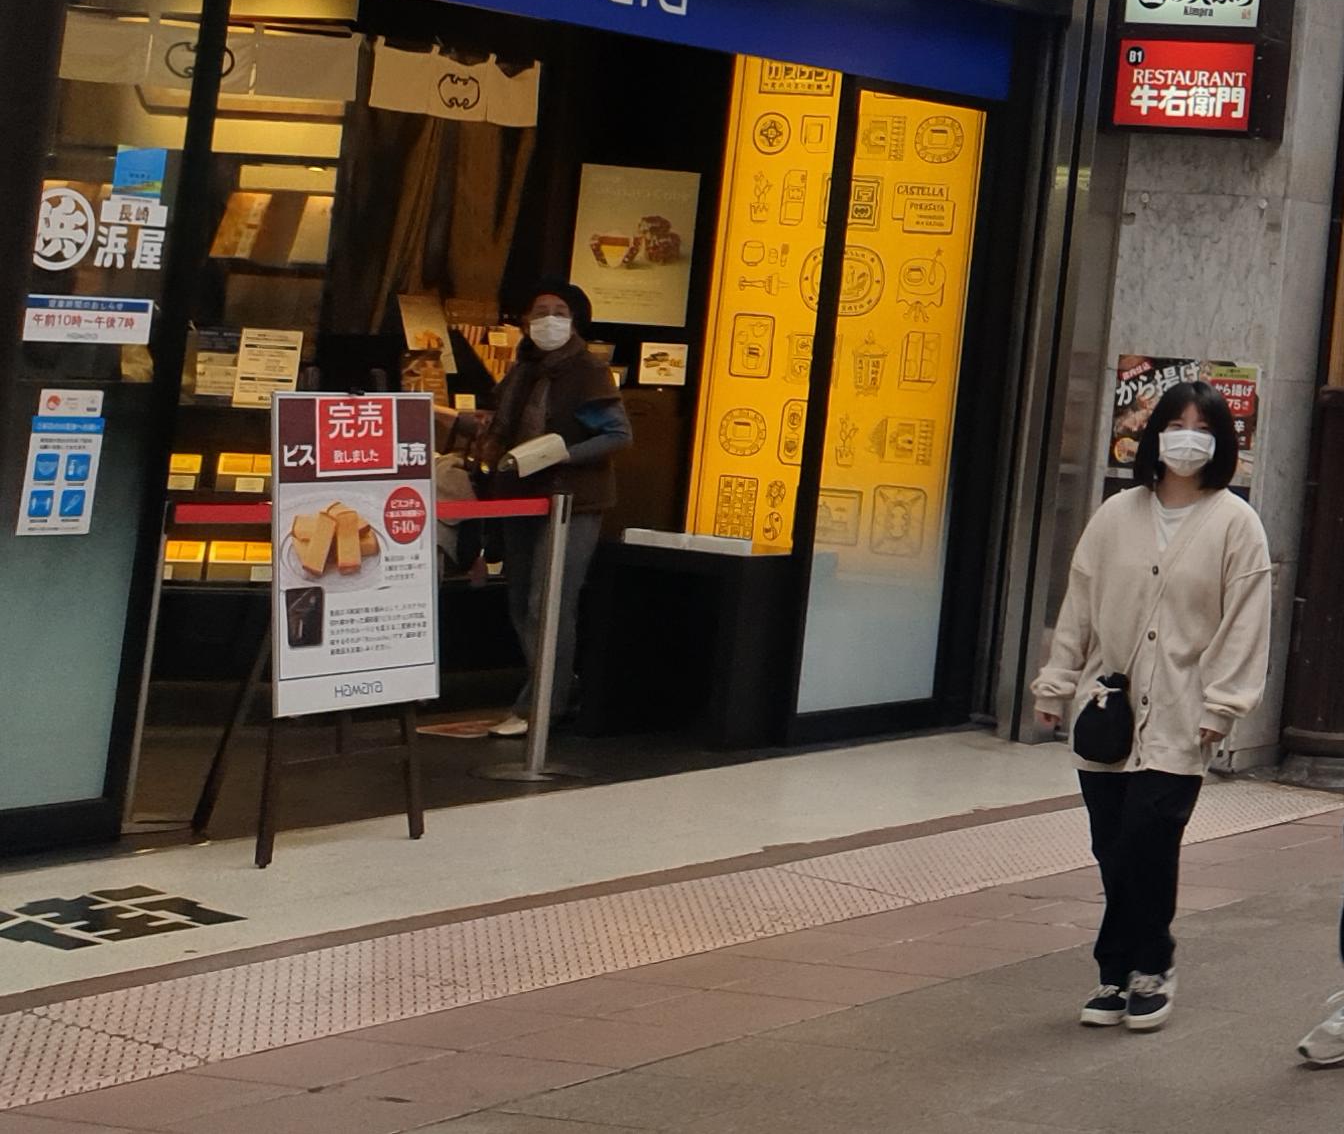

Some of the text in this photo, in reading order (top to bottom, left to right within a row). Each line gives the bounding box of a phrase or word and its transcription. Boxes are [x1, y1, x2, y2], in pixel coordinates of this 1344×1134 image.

[1133, 69, 1246, 86] RESTAURANT
[1130, 85, 1246, 118] 牛右衛門
[896, 184, 945, 197] CASTELLA
[93, 225, 166, 270] 浜屋
[328, 401, 384, 439] 完売
[333, 449, 379, 463] 致しました
